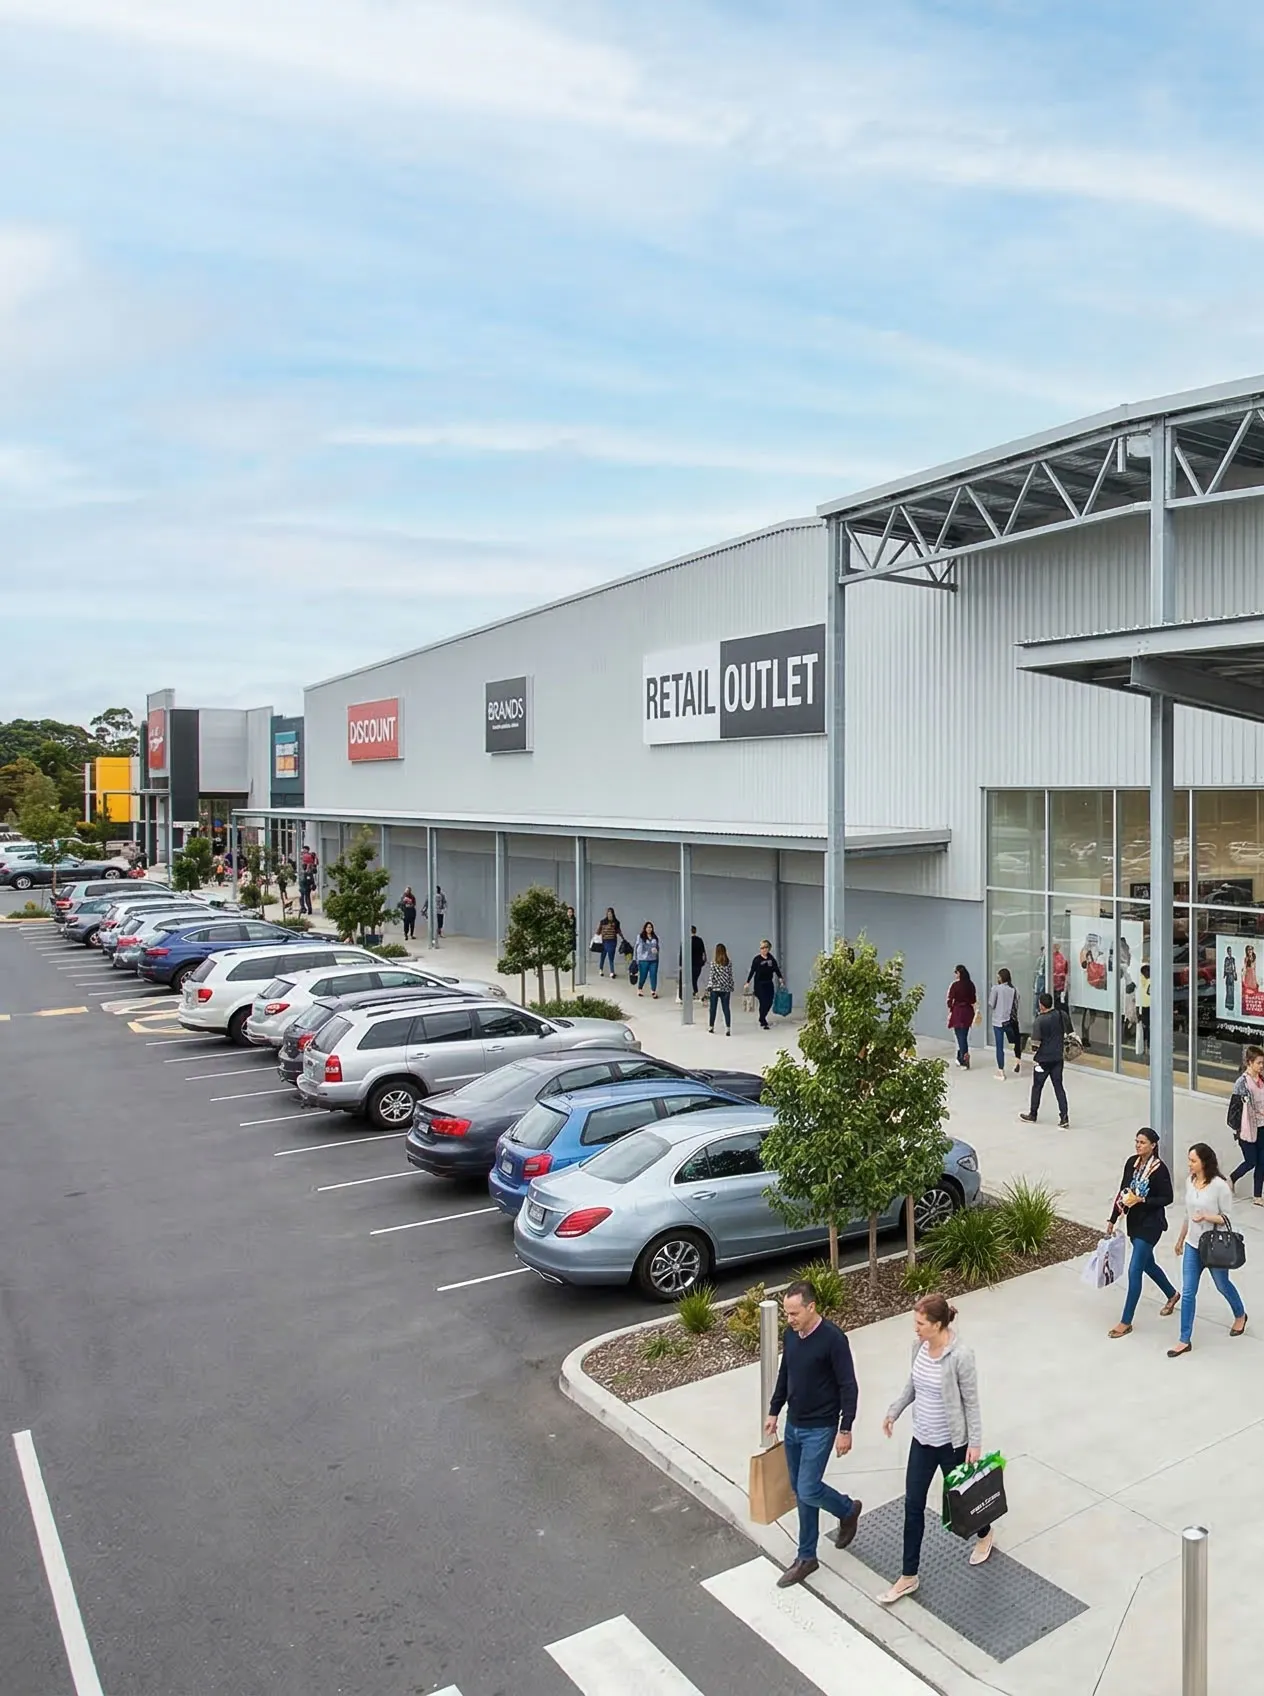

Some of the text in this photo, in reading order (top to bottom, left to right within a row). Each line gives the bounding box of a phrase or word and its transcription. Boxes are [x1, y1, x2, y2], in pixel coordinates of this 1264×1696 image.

[646, 652, 819, 720] RETAIL OUTLET
[488, 698, 524, 721] BRANDS
[350, 716, 396, 744] DISCOUNT
